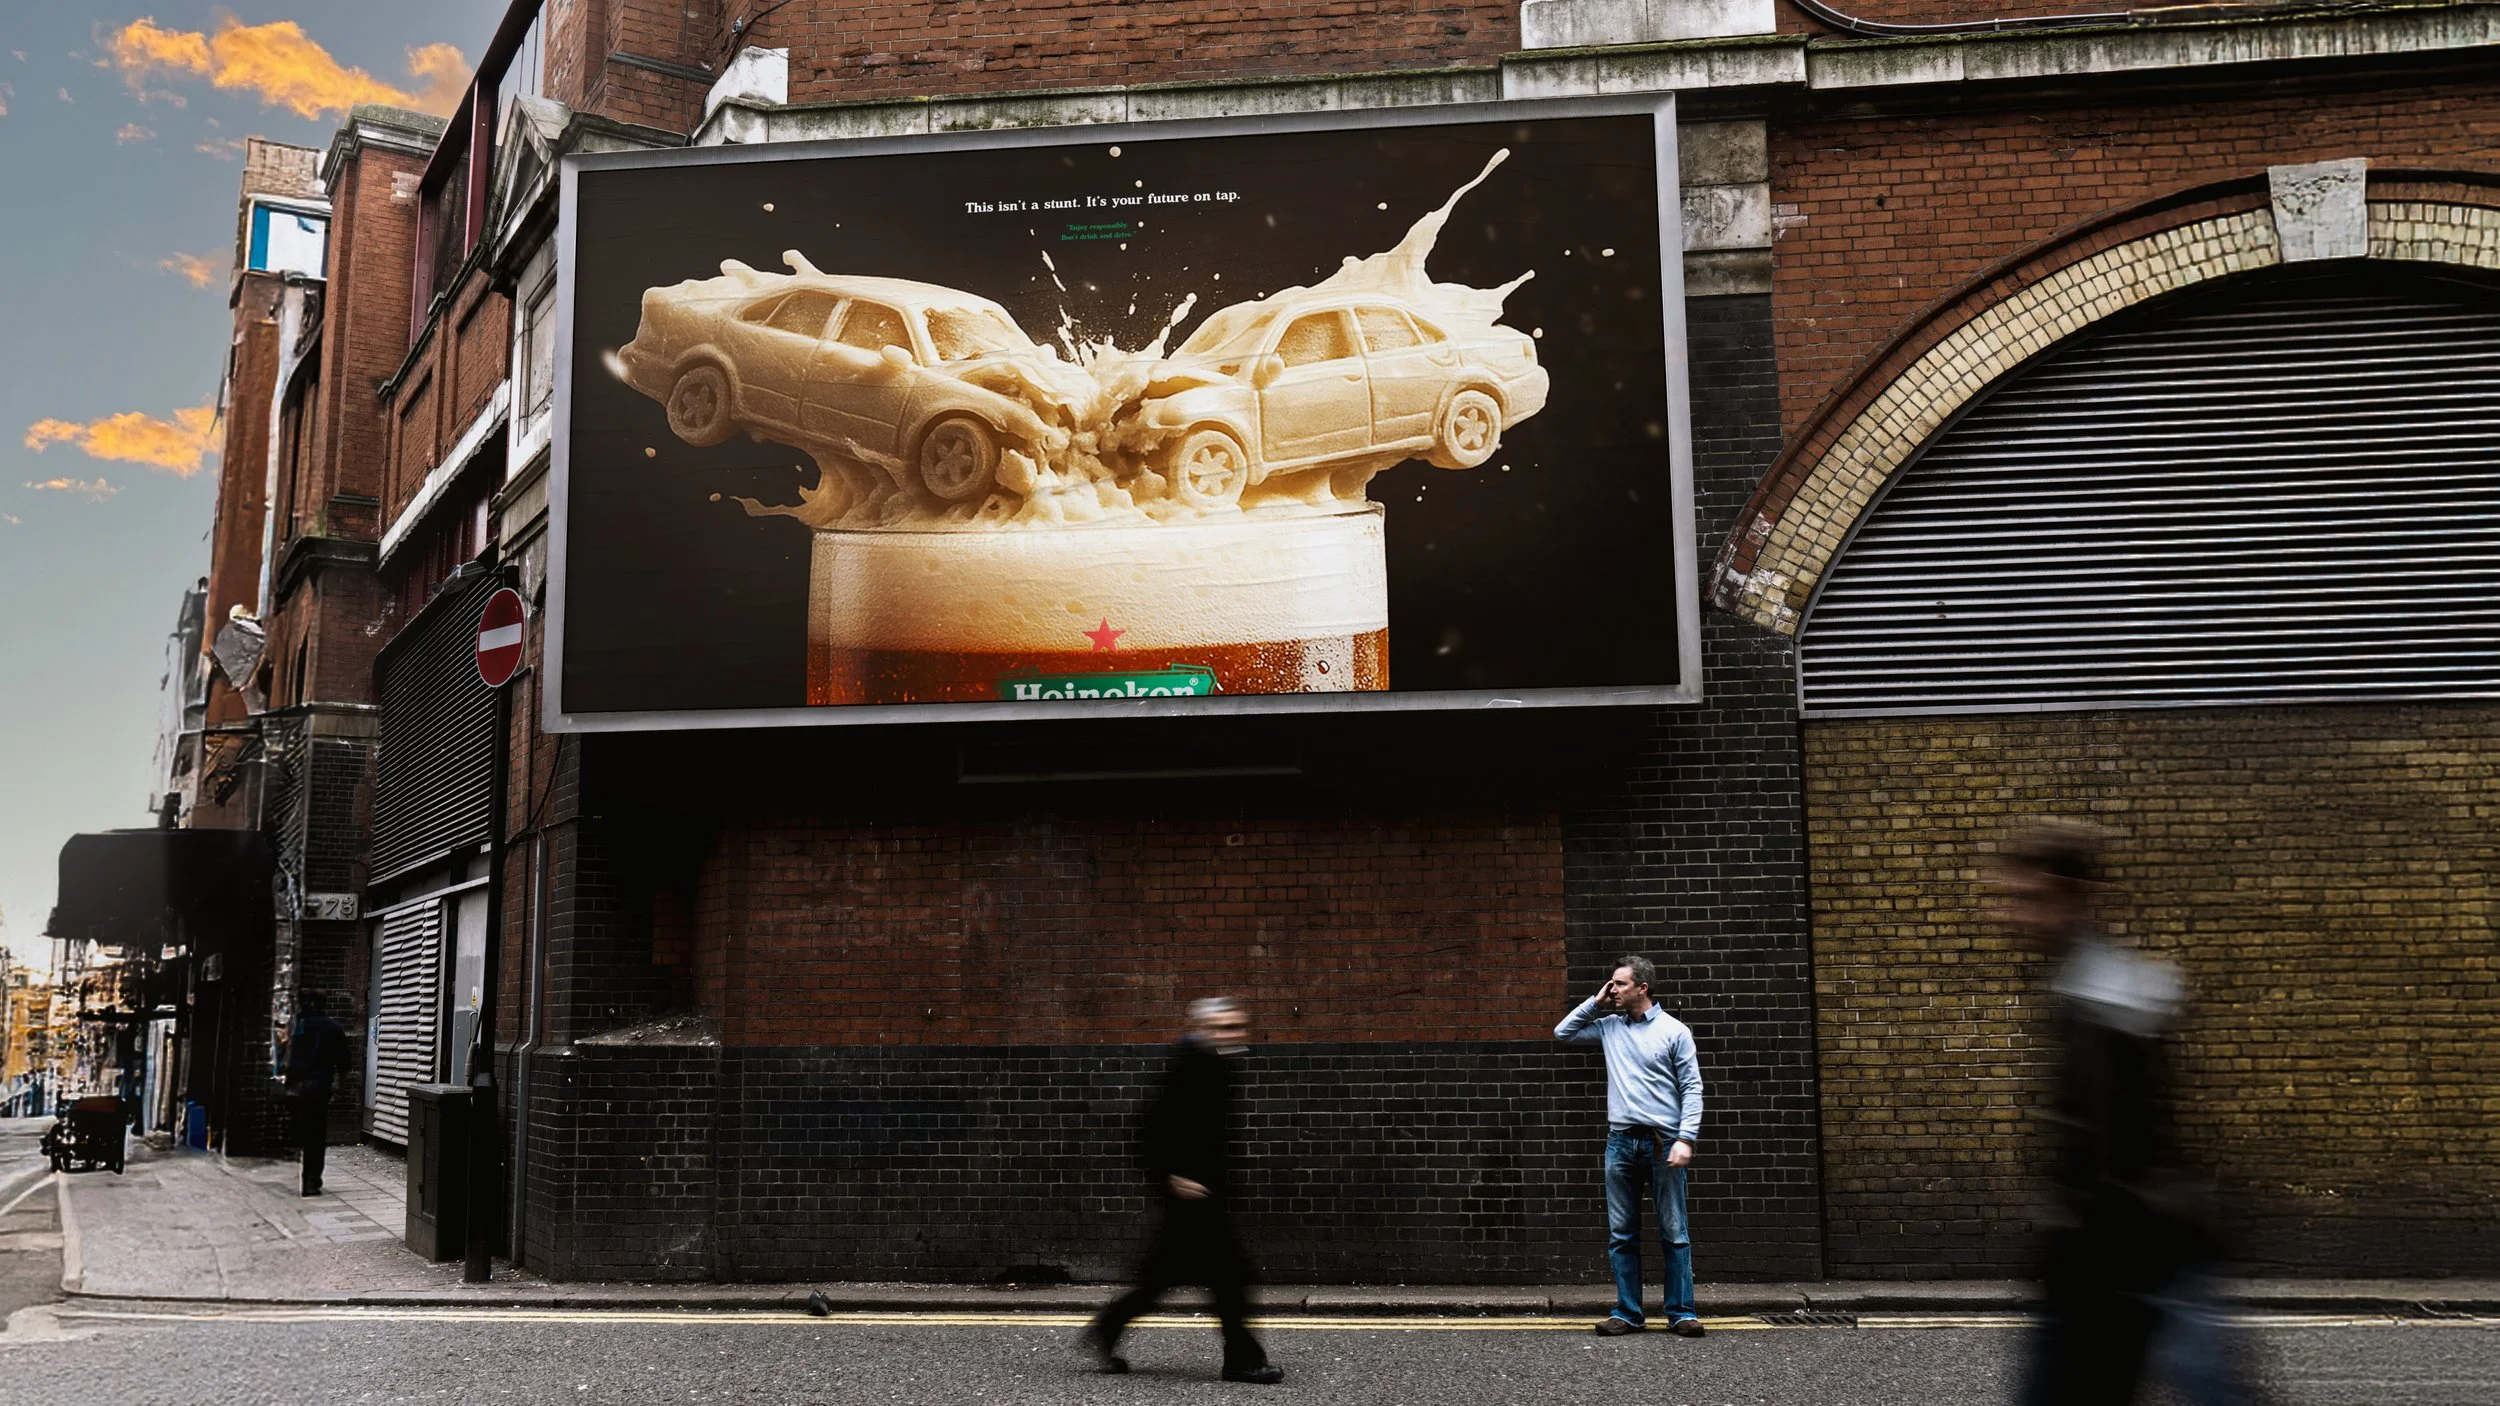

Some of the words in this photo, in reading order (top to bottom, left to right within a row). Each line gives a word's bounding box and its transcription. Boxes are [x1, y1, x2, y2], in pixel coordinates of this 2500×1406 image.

[965, 201, 994, 213] This
[998, 199, 1027, 212] isn't
[1031, 201, 1040, 210] a
[1043, 198, 1081, 209] stunt.
[1086, 196, 1107, 207] It's
[1112, 196, 1143, 208] your
[1147, 193, 1189, 204] future
[1193, 193, 1212, 202] on
[1216, 191, 1241, 202] tap.
